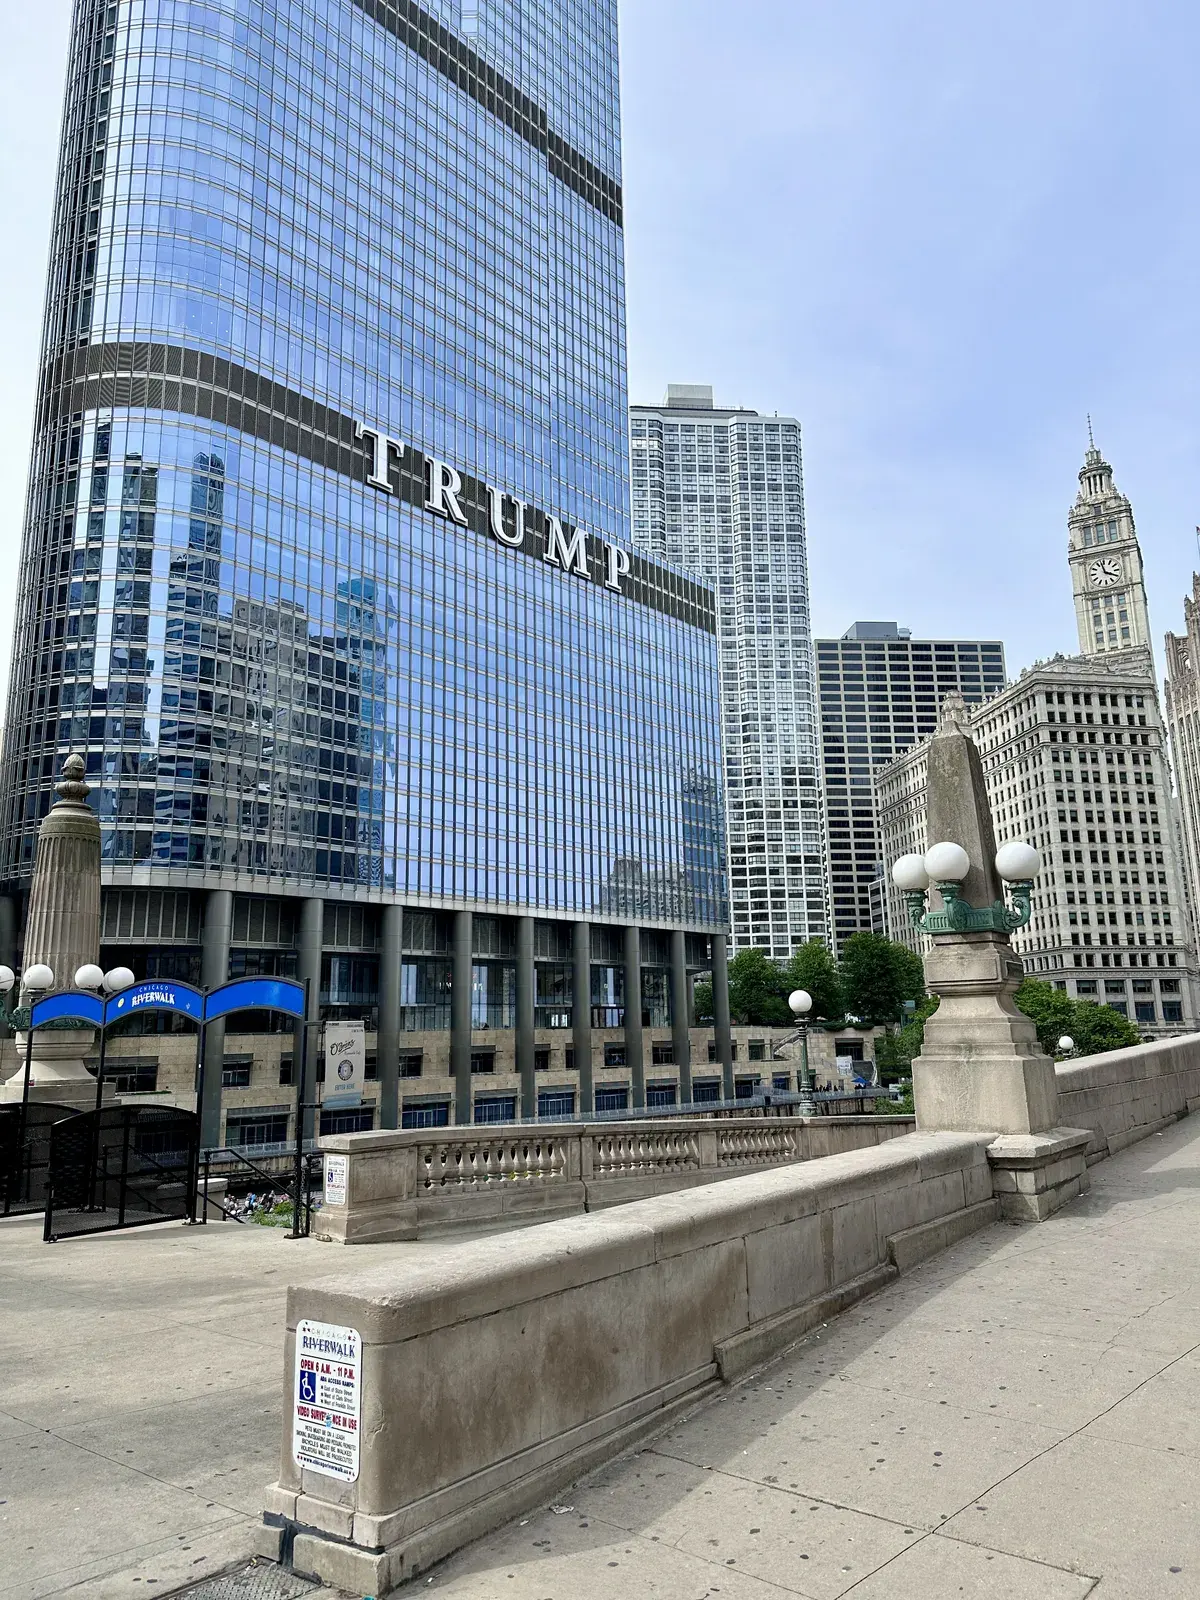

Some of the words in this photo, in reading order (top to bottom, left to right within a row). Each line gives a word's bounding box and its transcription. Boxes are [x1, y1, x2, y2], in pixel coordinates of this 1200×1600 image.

[355, 421, 630, 593] TRUMP
[139, 984, 169, 992] CHICAGO
[132, 992, 175, 1007] RIVERWALK
[312, 1328, 347, 1340] CHICAGO
[303, 1336, 355, 1358] RIVERWALK
[301, 1359, 314, 1371] OPEN
[316, 1362, 319, 1372] 6
[321, 1364, 332, 1374] A.M.
[338, 1367, 342, 1377] 11
[344, 1368, 355, 1380] P.M.
[297, 1406, 309, 1418] VIDEO
[343, 1416, 347, 1427] IN
[348, 1418, 357, 1430] USE
[302, 1438, 318, 1448] BICYCLES
